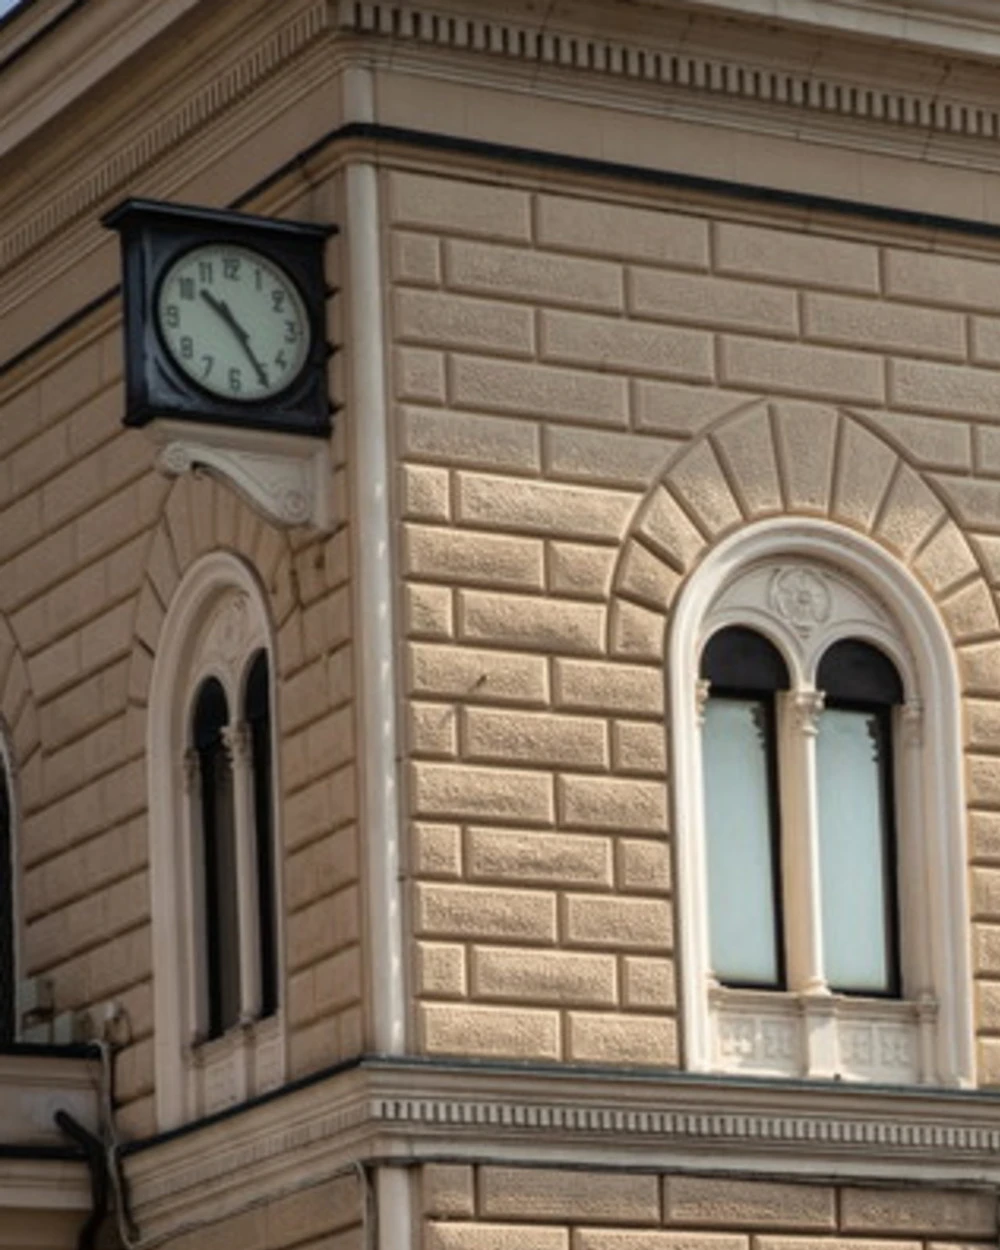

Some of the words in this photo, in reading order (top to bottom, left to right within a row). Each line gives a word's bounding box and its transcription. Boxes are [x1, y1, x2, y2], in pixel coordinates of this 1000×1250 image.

[199, 261, 213, 284] 11
[222, 258, 241, 281] 12
[254, 268, 263, 291] 1
[179, 277, 196, 300] 10
[271, 289, 285, 314] 2
[166, 304, 181, 328] 9
[284, 320, 297, 344] 3
[179, 336, 194, 359] 8
[202, 355, 215, 379] 7
[275, 348, 287, 371] 4
[228, 367, 242, 392] 6
